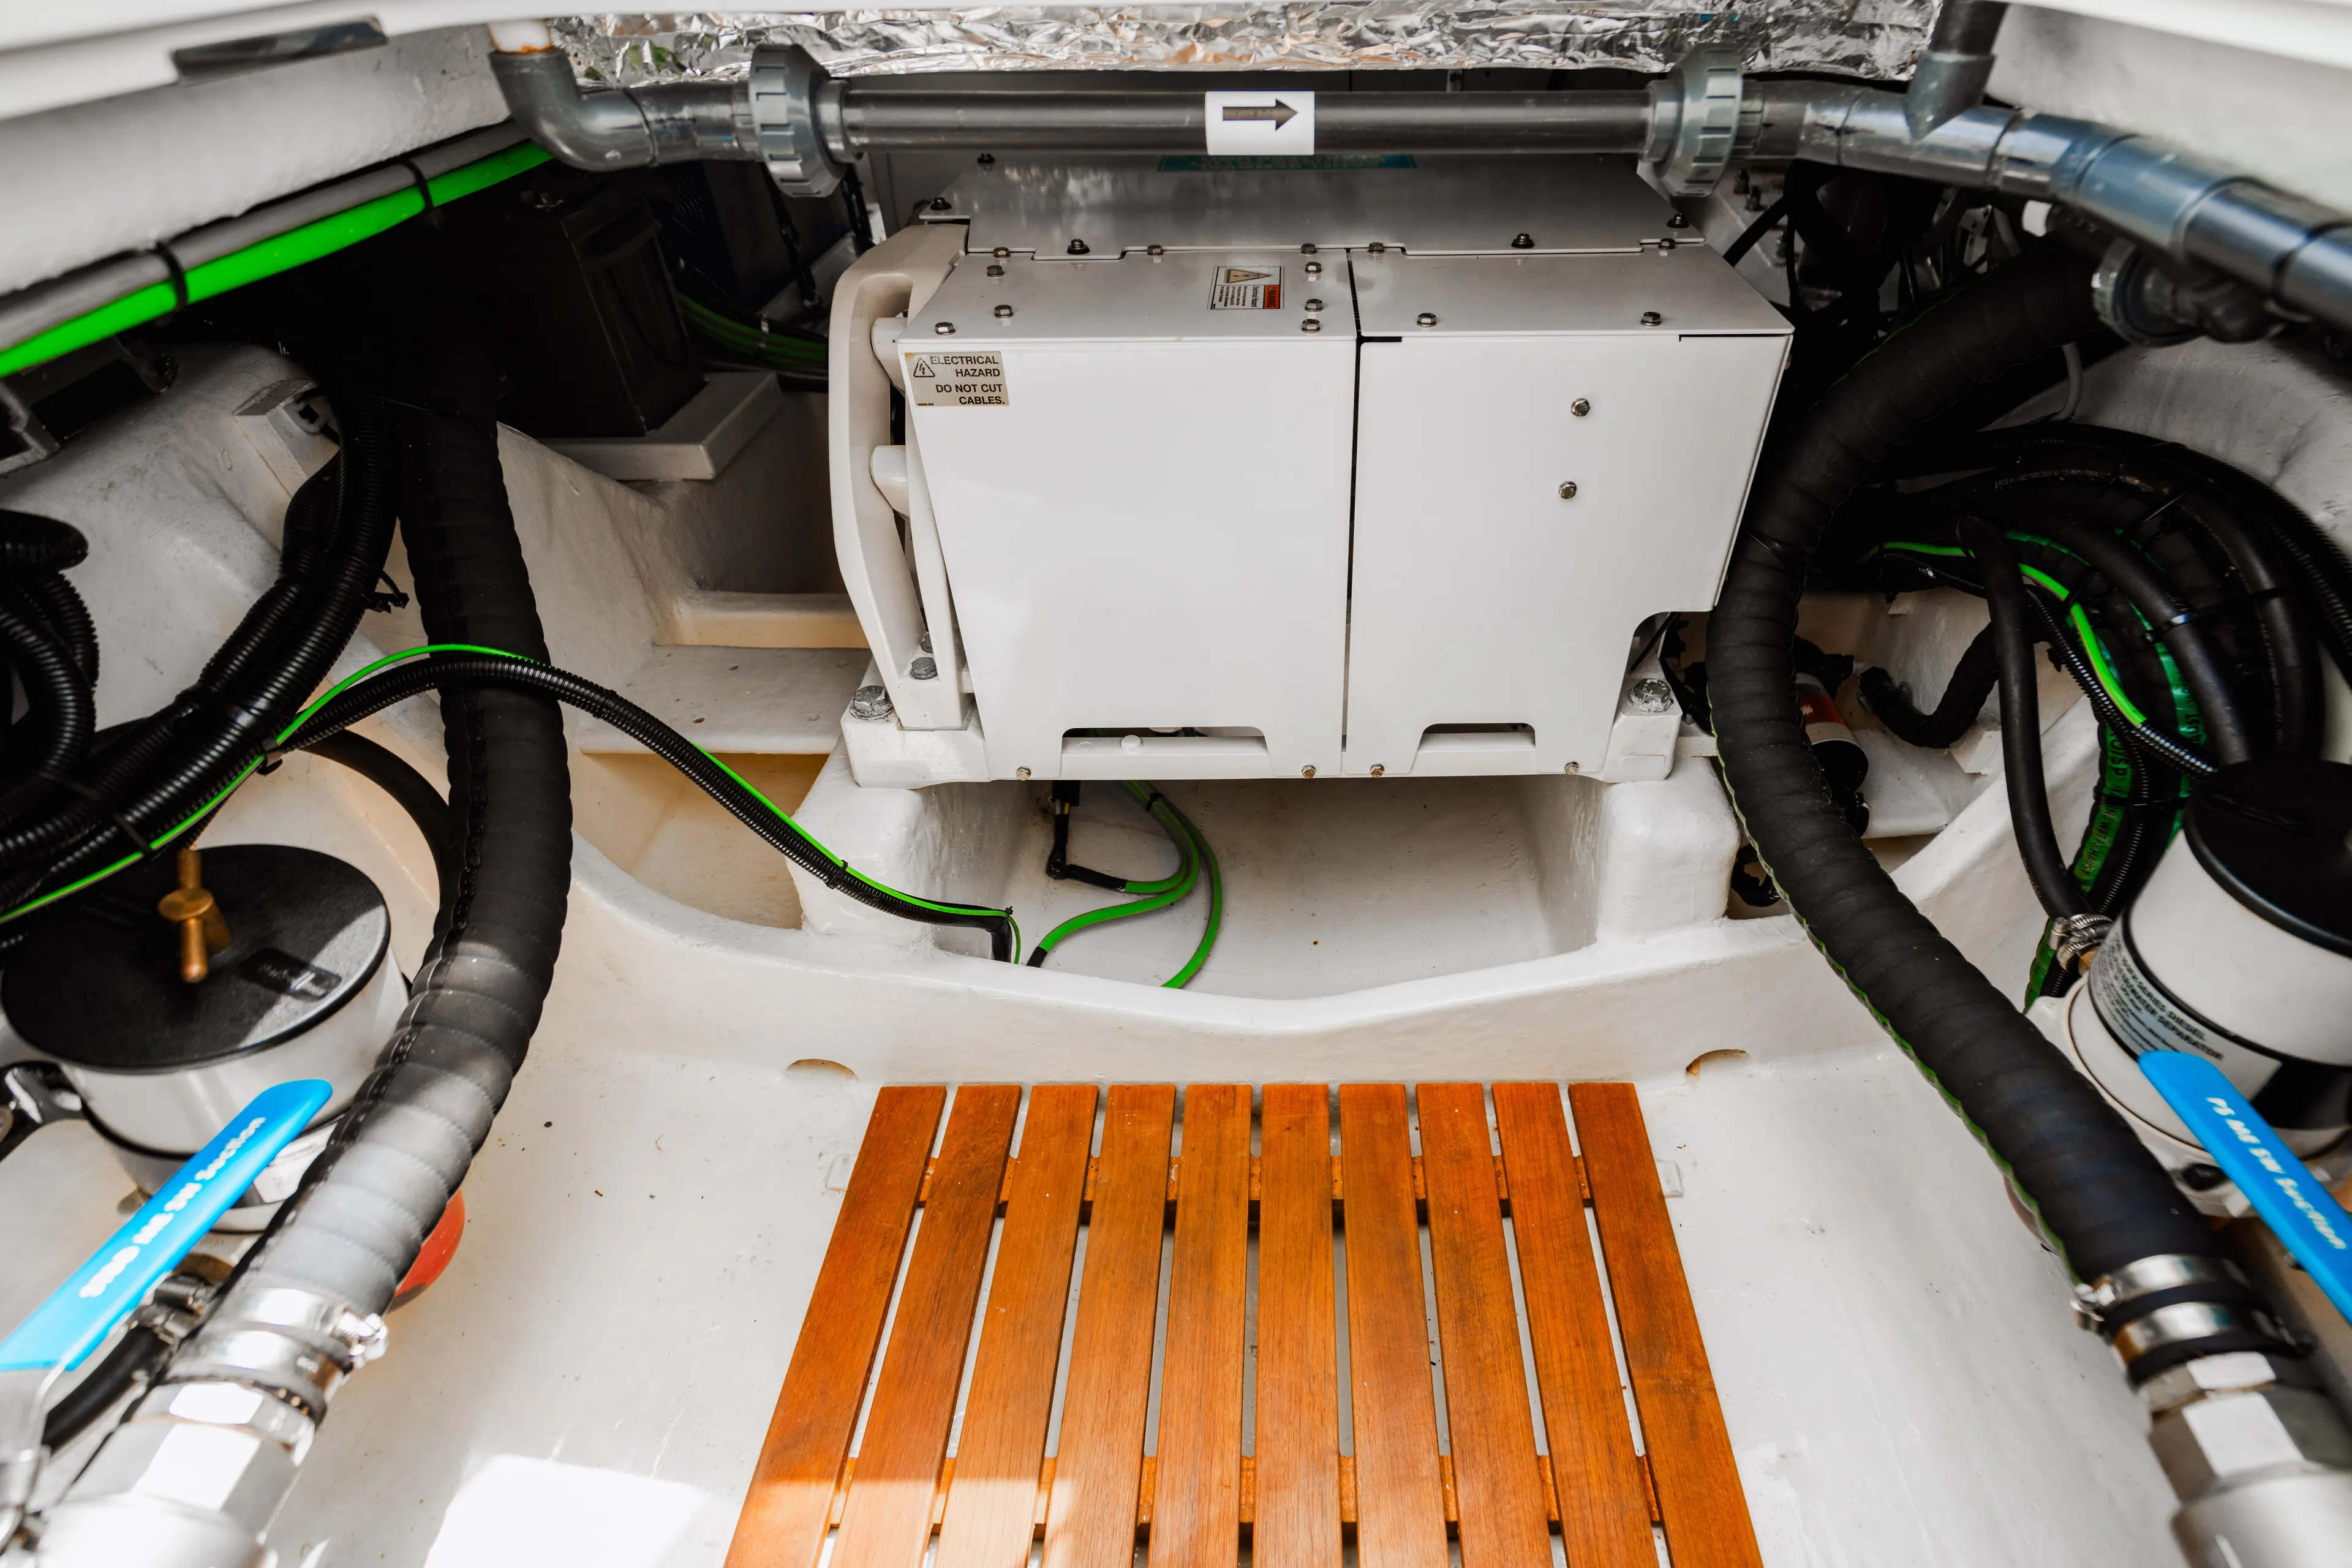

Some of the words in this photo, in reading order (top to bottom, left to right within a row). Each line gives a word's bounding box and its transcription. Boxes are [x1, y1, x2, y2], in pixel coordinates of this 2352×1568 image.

[930, 356, 999, 365] ELECTRICAL
[956, 369, 1000, 377] HAZARD
[936, 384, 952, 393] DO
[956, 384, 978, 393] NOT
[981, 383, 1003, 392] CUT
[959, 396, 1005, 405] CABLES.
[2137, 981, 2168, 1012] SERIES
[2168, 1011, 2206, 1042] DIESEL
[2156, 1014, 2224, 1060] SEPARATOR
